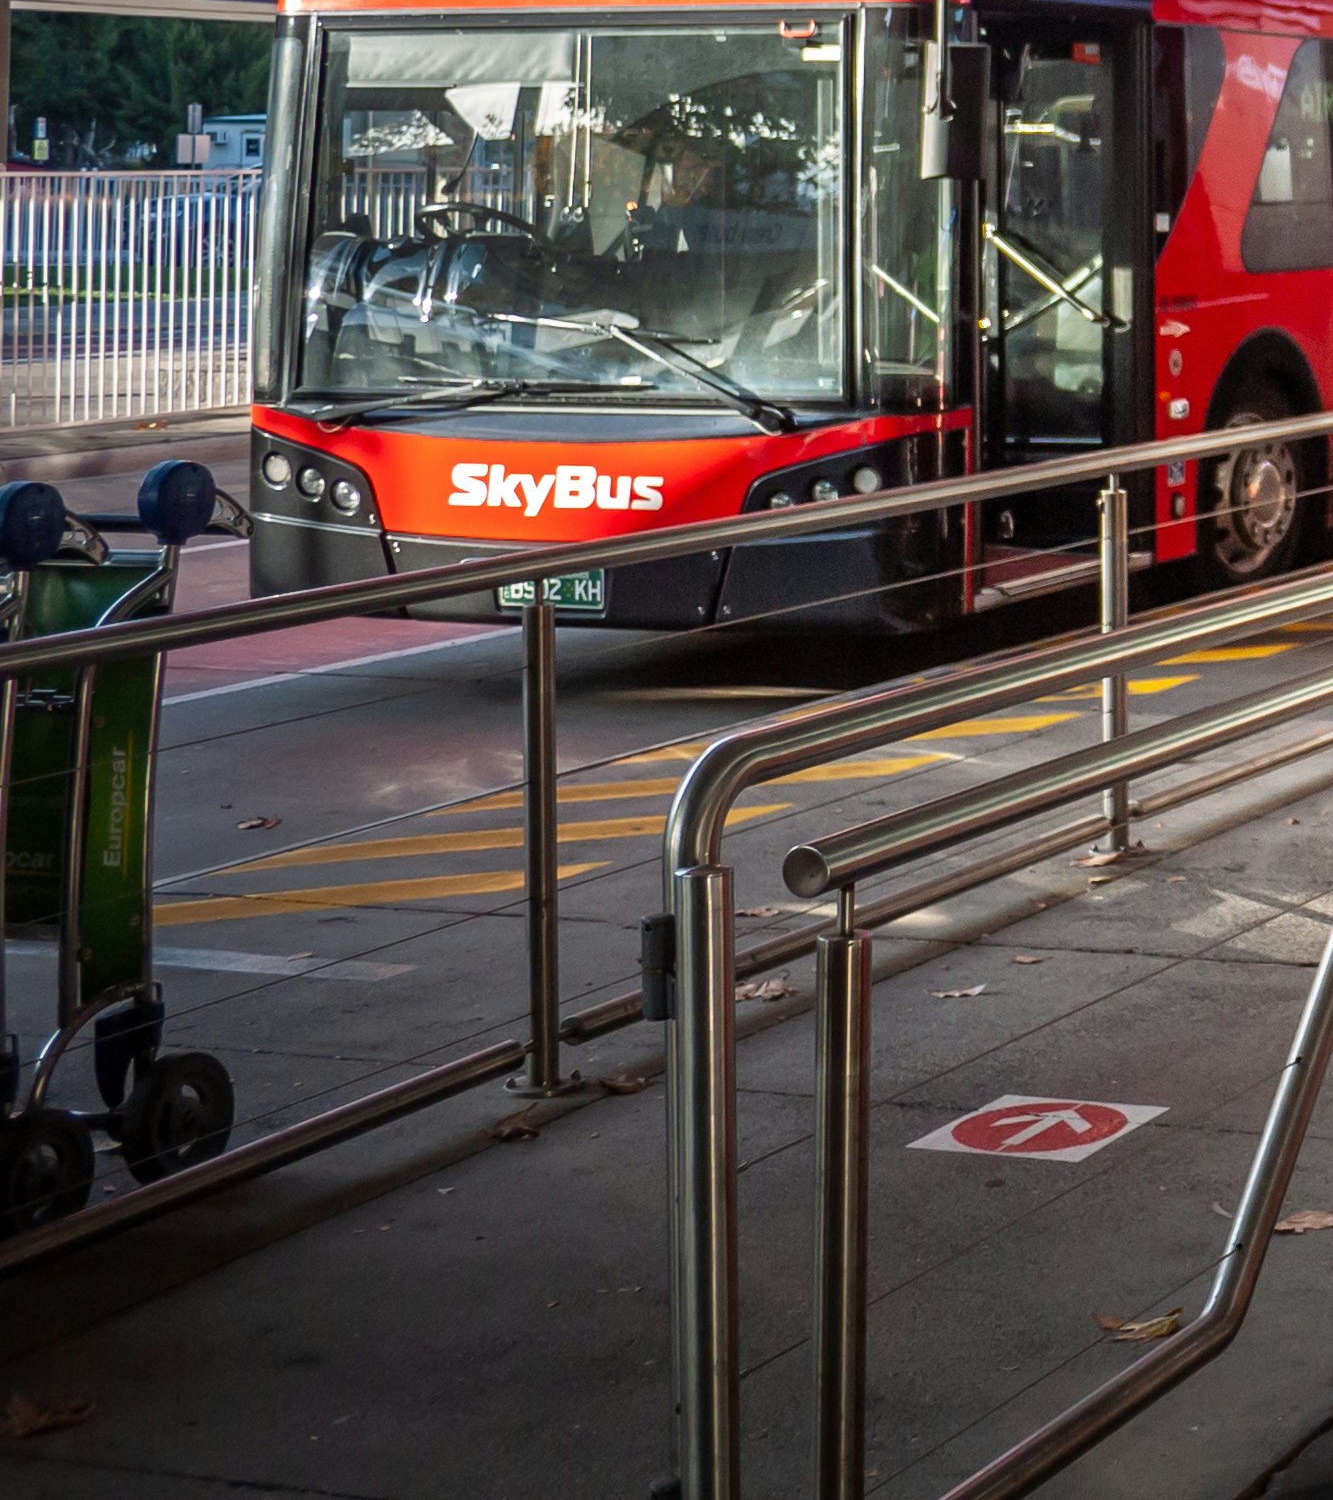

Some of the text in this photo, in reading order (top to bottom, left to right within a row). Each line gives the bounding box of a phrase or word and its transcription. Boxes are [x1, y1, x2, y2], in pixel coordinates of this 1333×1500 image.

[449, 462, 665, 518] SkyBus
[574, 579, 602, 602] KH
[103, 745, 128, 867] Europcar
